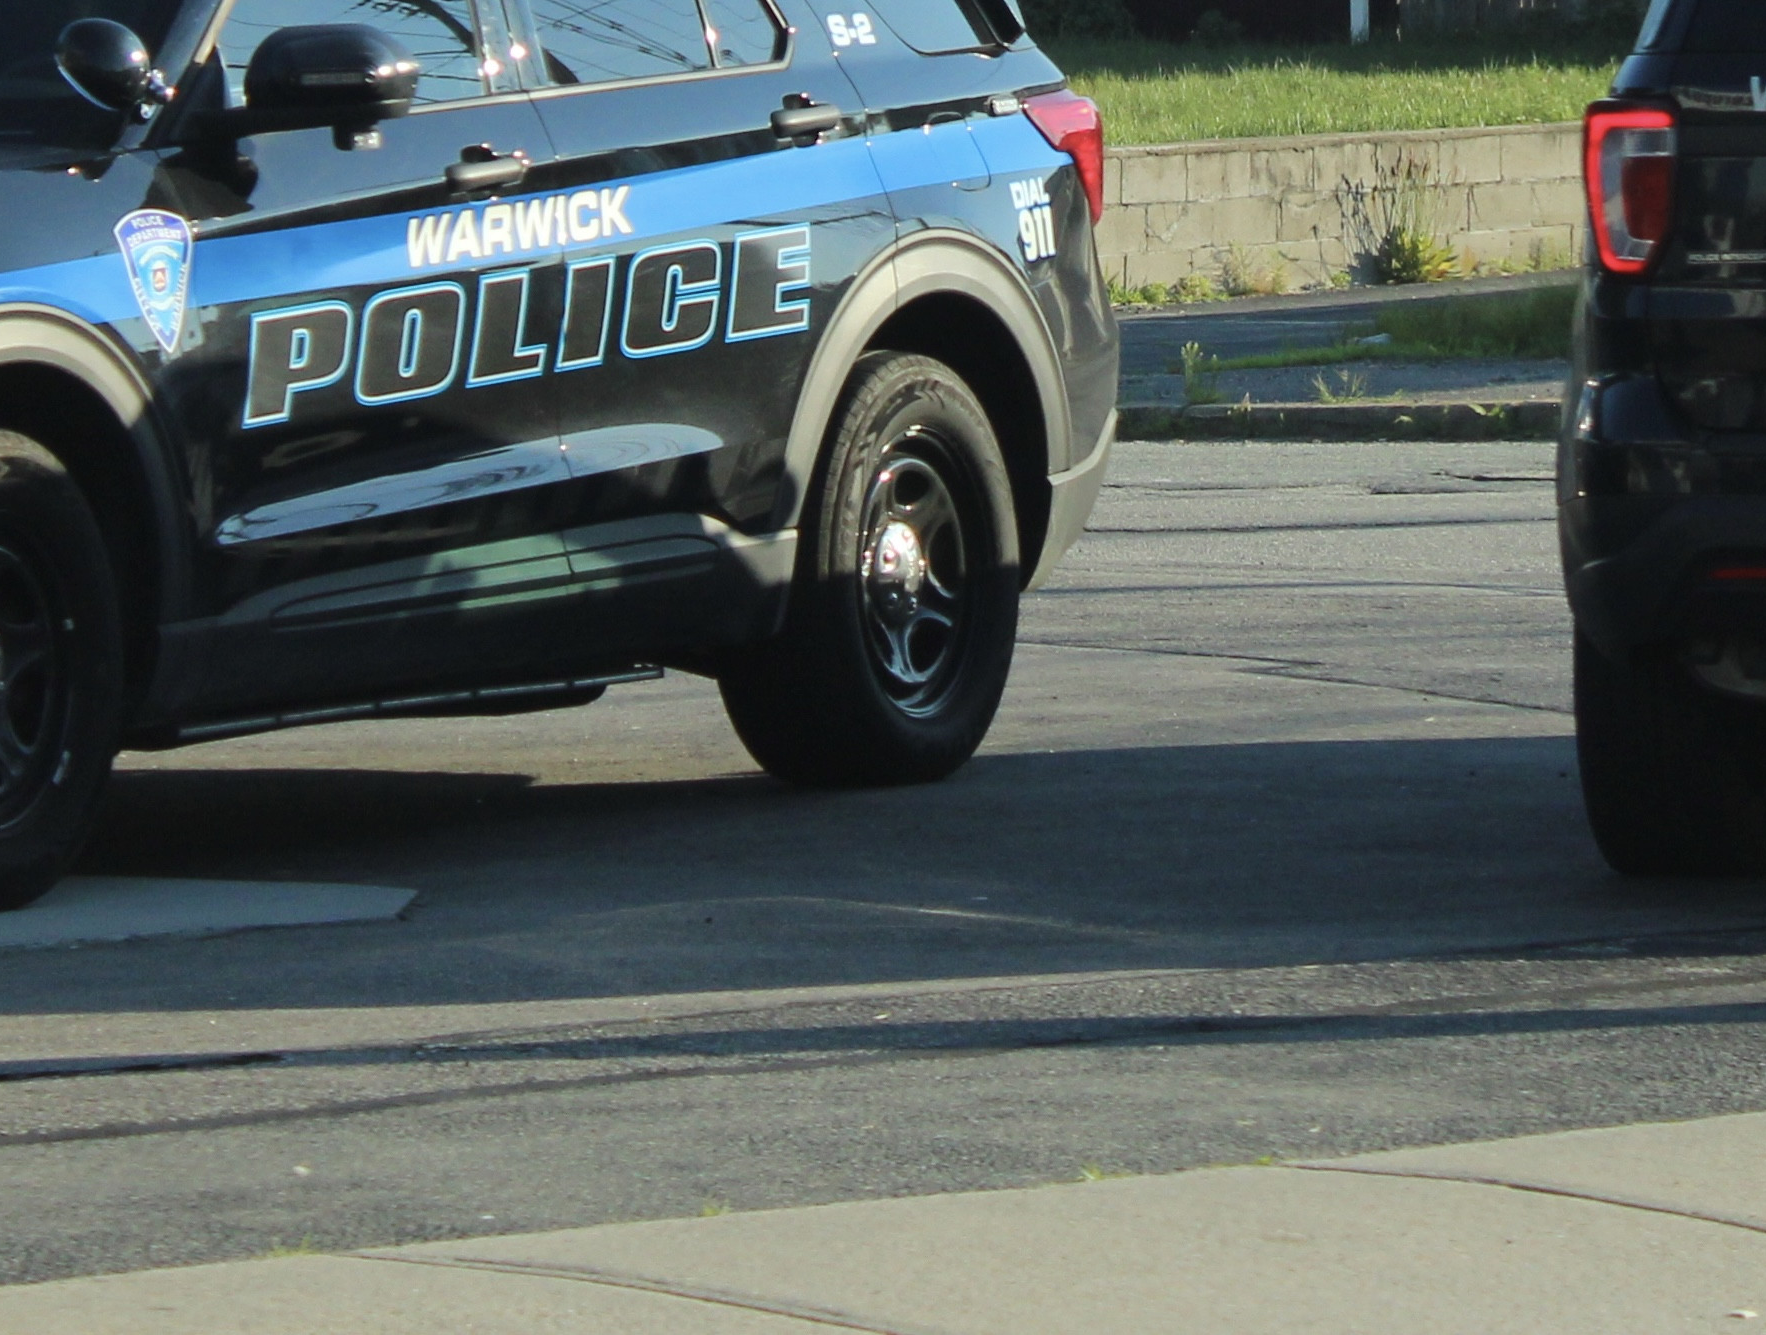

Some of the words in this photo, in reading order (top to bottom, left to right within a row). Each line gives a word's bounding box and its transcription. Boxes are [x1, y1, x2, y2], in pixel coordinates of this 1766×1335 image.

[827, 12, 877, 46] S-2
[1009, 176, 1050, 210] DIAL
[126, 227, 182, 248] DEPARTMENT
[131, 215, 165, 229] POLICE
[407, 185, 632, 268] WARWICK
[1018, 205, 1056, 262] 911
[242, 222, 811, 429] POLICE
